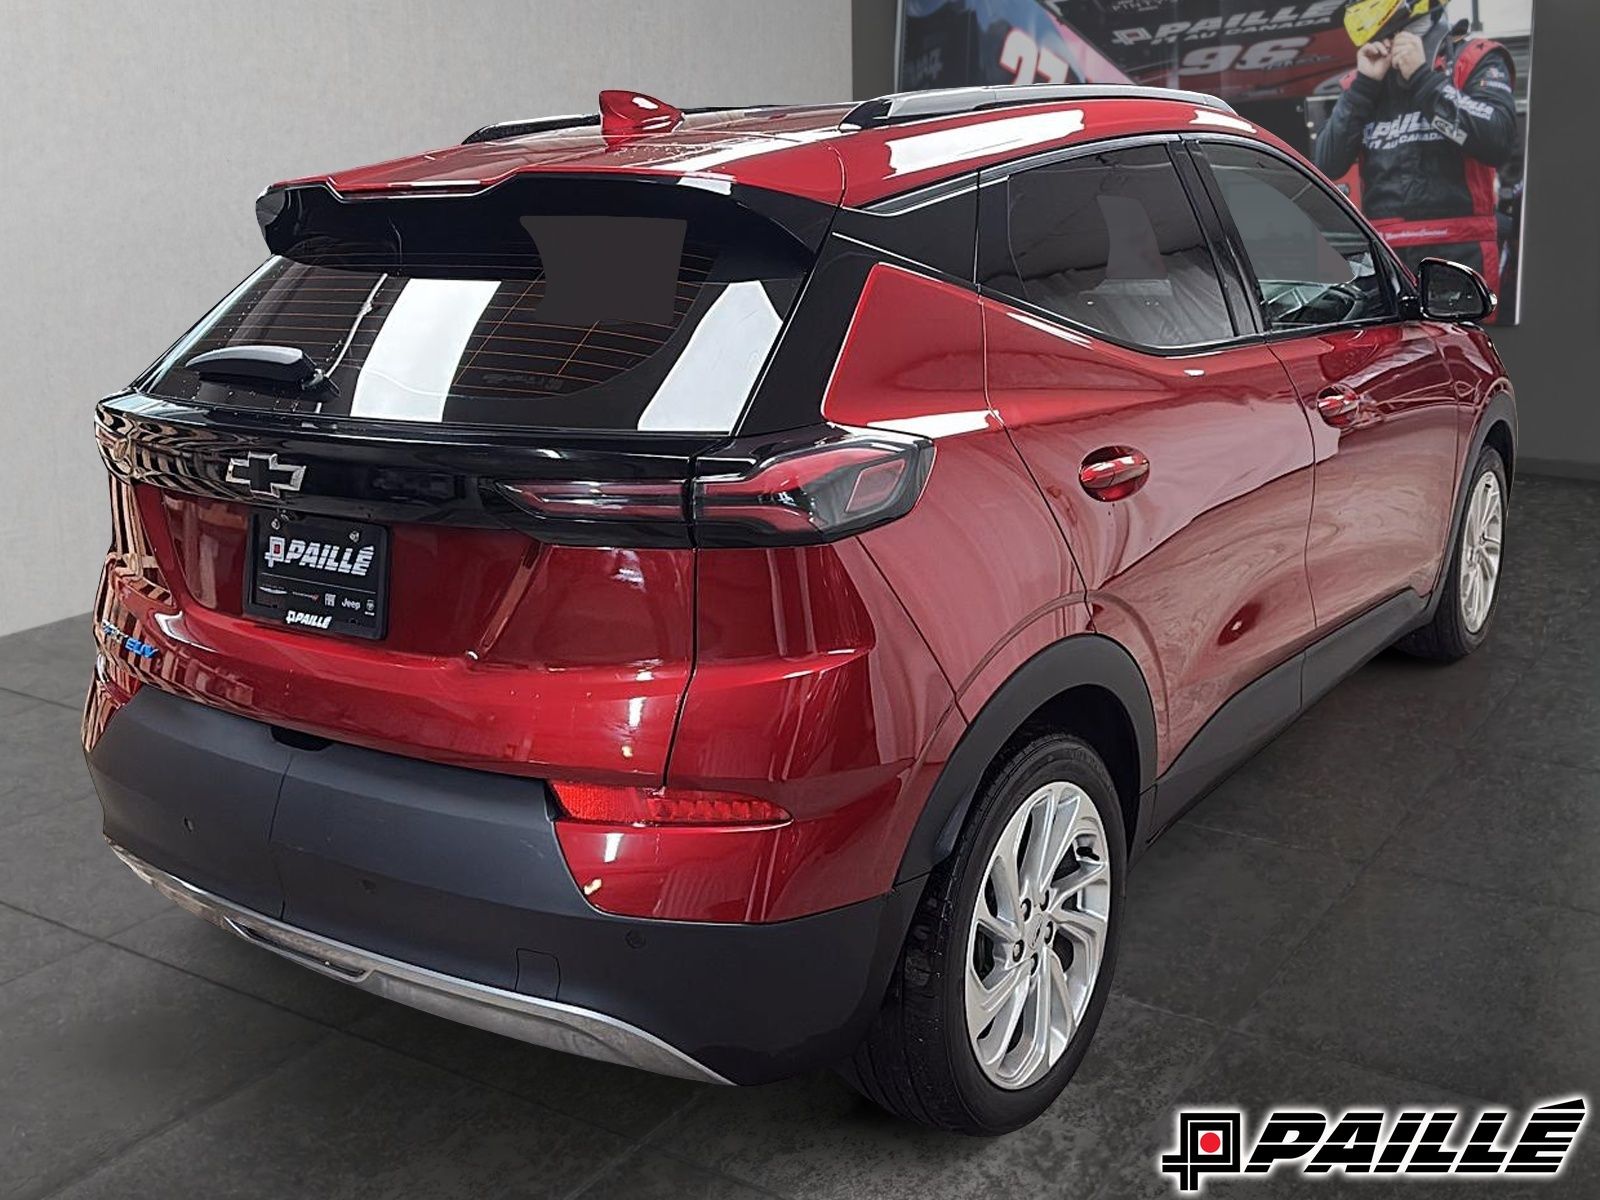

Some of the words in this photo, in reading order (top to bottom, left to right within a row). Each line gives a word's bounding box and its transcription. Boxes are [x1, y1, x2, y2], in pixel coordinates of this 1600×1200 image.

[1223, 17, 1332, 36] CANADA
[1179, 37, 1310, 76] 96
[284, 539, 375, 576] PAILLÉ
[341, 598, 361, 611] Jeep
